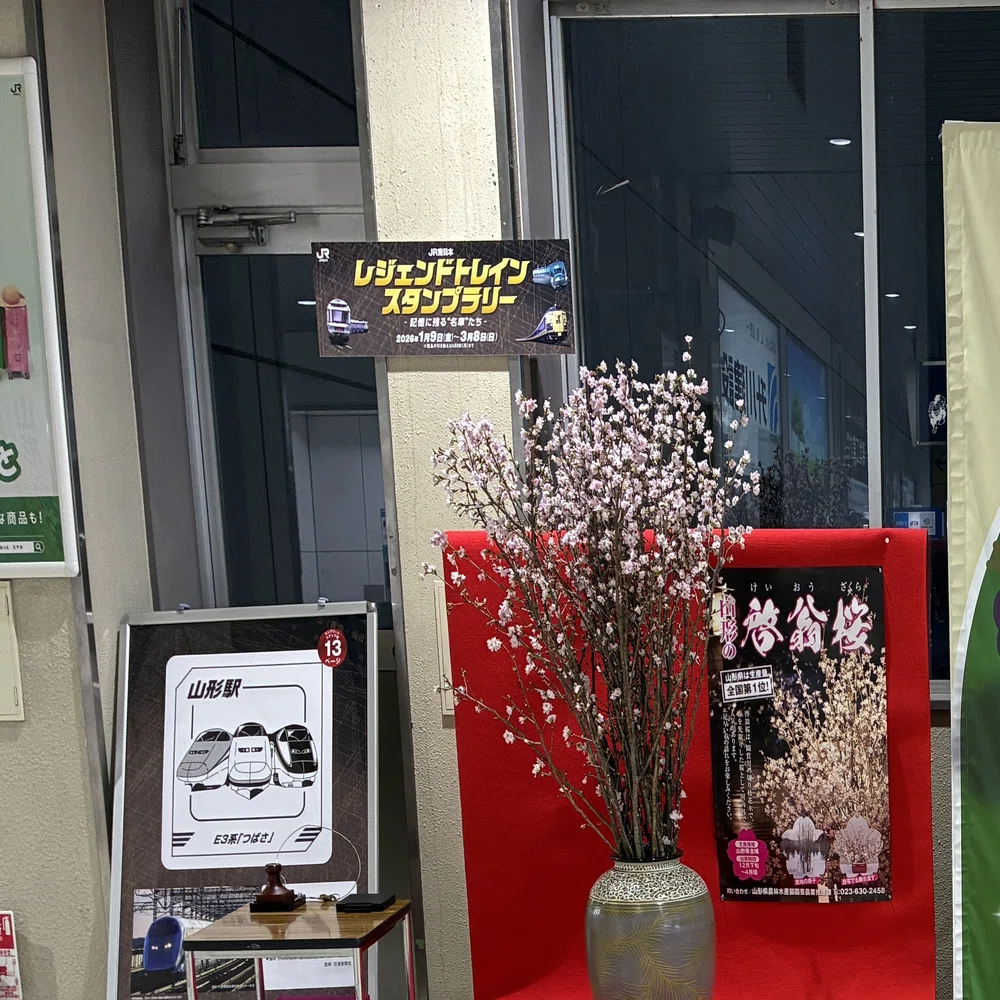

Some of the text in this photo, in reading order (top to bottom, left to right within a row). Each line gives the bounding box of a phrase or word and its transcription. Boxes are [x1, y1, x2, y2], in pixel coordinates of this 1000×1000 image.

[316, 248, 330, 259] JR
[353, 257, 531, 287] レジェンドトレイン
[381, 286, 518, 315] スタンプラリー
[740, 594, 873, 657] 啓翁桜
[324, 639, 342, 657] 13
[324, 657, 341, 665] ページ
[187, 678, 243, 700] 山形駅
[213, 832, 275, 845] E3系「つばさ」
